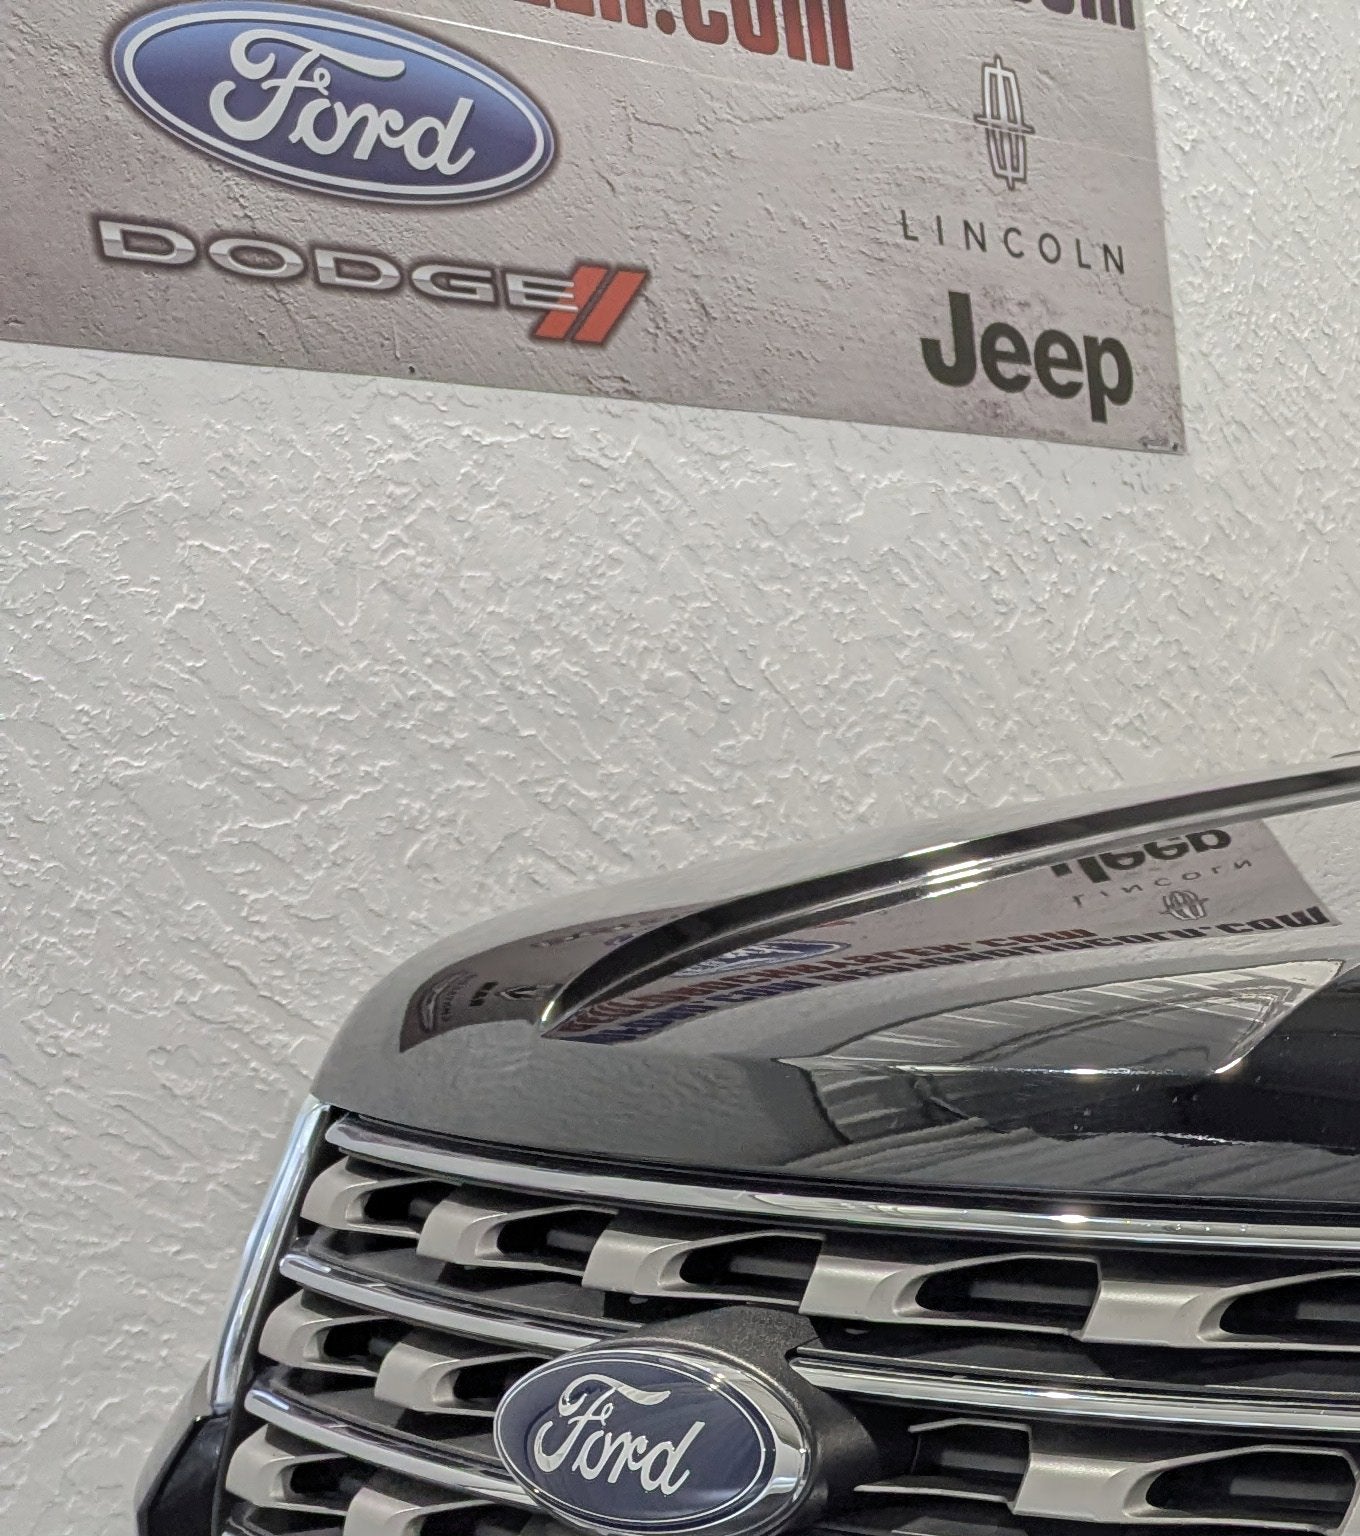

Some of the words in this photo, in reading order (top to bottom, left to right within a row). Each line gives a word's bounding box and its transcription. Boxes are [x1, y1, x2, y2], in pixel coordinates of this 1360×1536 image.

[209, 28, 475, 176] Ford
[99, 220, 579, 314] DODGE
[900, 209, 1125, 275] LINCOLN
[920, 290, 1133, 424] Jeep
[534, 1374, 705, 1496] Ford
